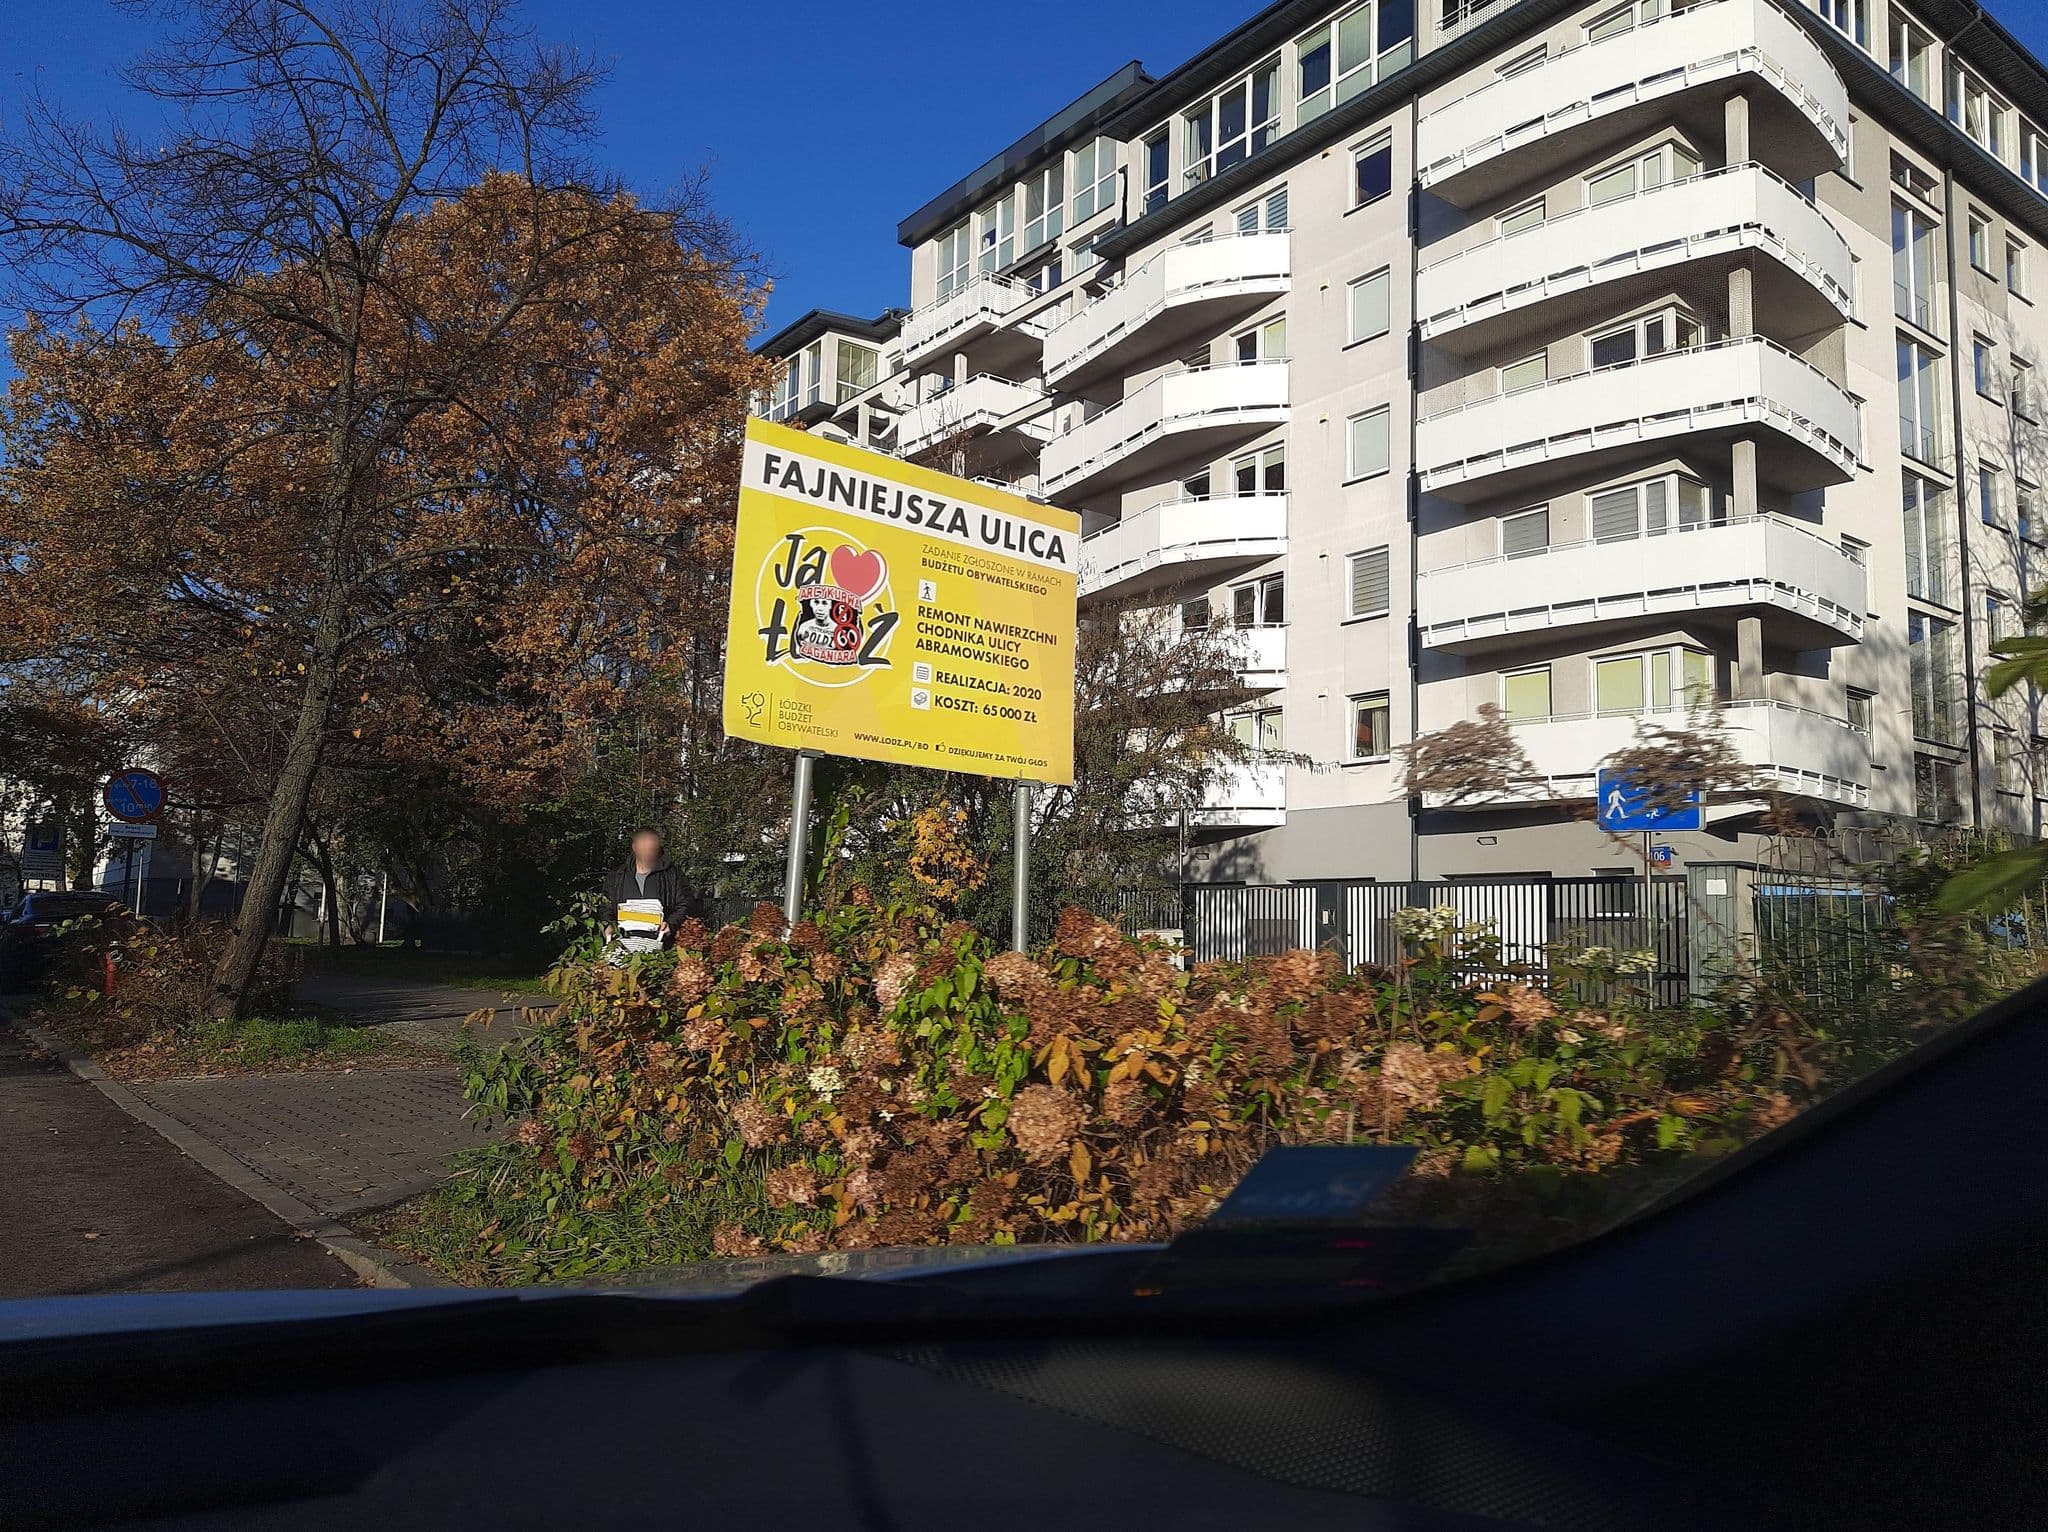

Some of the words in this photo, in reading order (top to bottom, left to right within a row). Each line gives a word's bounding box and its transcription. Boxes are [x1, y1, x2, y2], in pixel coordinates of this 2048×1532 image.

[763, 453, 970, 538] FAJNIEJSZA
[980, 514, 1067, 564] ULICA
[775, 534, 827, 589] Ja
[921, 558, 964, 576] BUDŻETU
[967, 569, 1048, 596] OBYWATELSKIEGO
[922, 544, 961, 563] ZADANIE
[963, 554, 1015, 576] ZGŁOSZONE
[1016, 568, 1026, 578] W
[1027, 571, 1062, 588] RAMACH
[917, 622, 985, 646] CHODNIKA
[988, 636, 1022, 653] ULICY
[918, 605, 971, 627] REMONT
[974, 618, 1058, 646] NAWIERZCHNI
[916, 638, 1030, 670] ABRAMOWSKIEGO
[936, 671, 1011, 695] REALIZACJA:
[1013, 685, 1042, 700] 2020
[779, 698, 812, 713] ŁÓDZKI
[934, 695, 978, 714] KOSZT:
[983, 704, 998, 717] 65
[1000, 706, 1022, 720] 000
[1024, 710, 1038, 723] ZŁ
[778, 721, 839, 738] OBYWATELSKI
[854, 732, 929, 750] WWW.LODZ.PL/BO
[995, 753, 1005, 761] ZA
[1028, 758, 1048, 767] GŁOS
